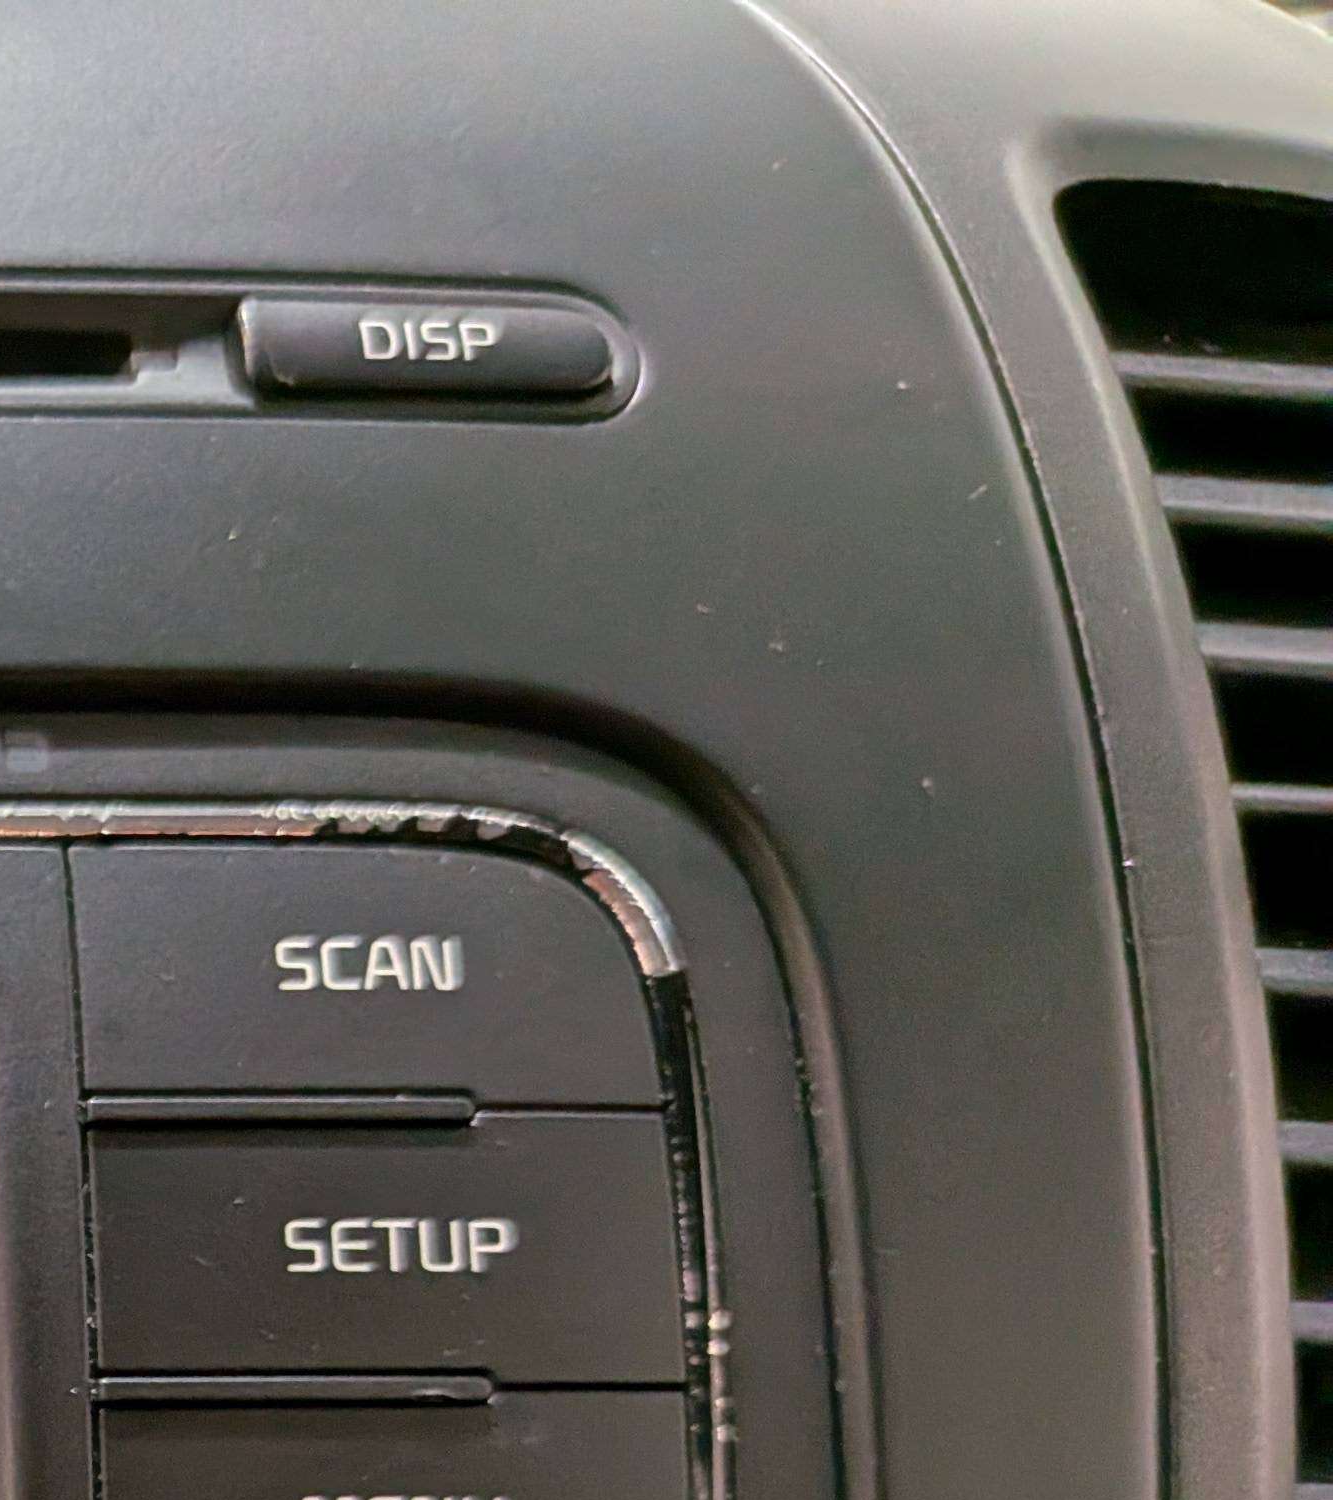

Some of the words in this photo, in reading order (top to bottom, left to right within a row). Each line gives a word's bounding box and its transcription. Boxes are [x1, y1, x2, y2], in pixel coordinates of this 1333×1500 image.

[358, 318, 498, 361] DISP
[274, 934, 464, 991] SCAN
[283, 1216, 520, 1273] SETUP
